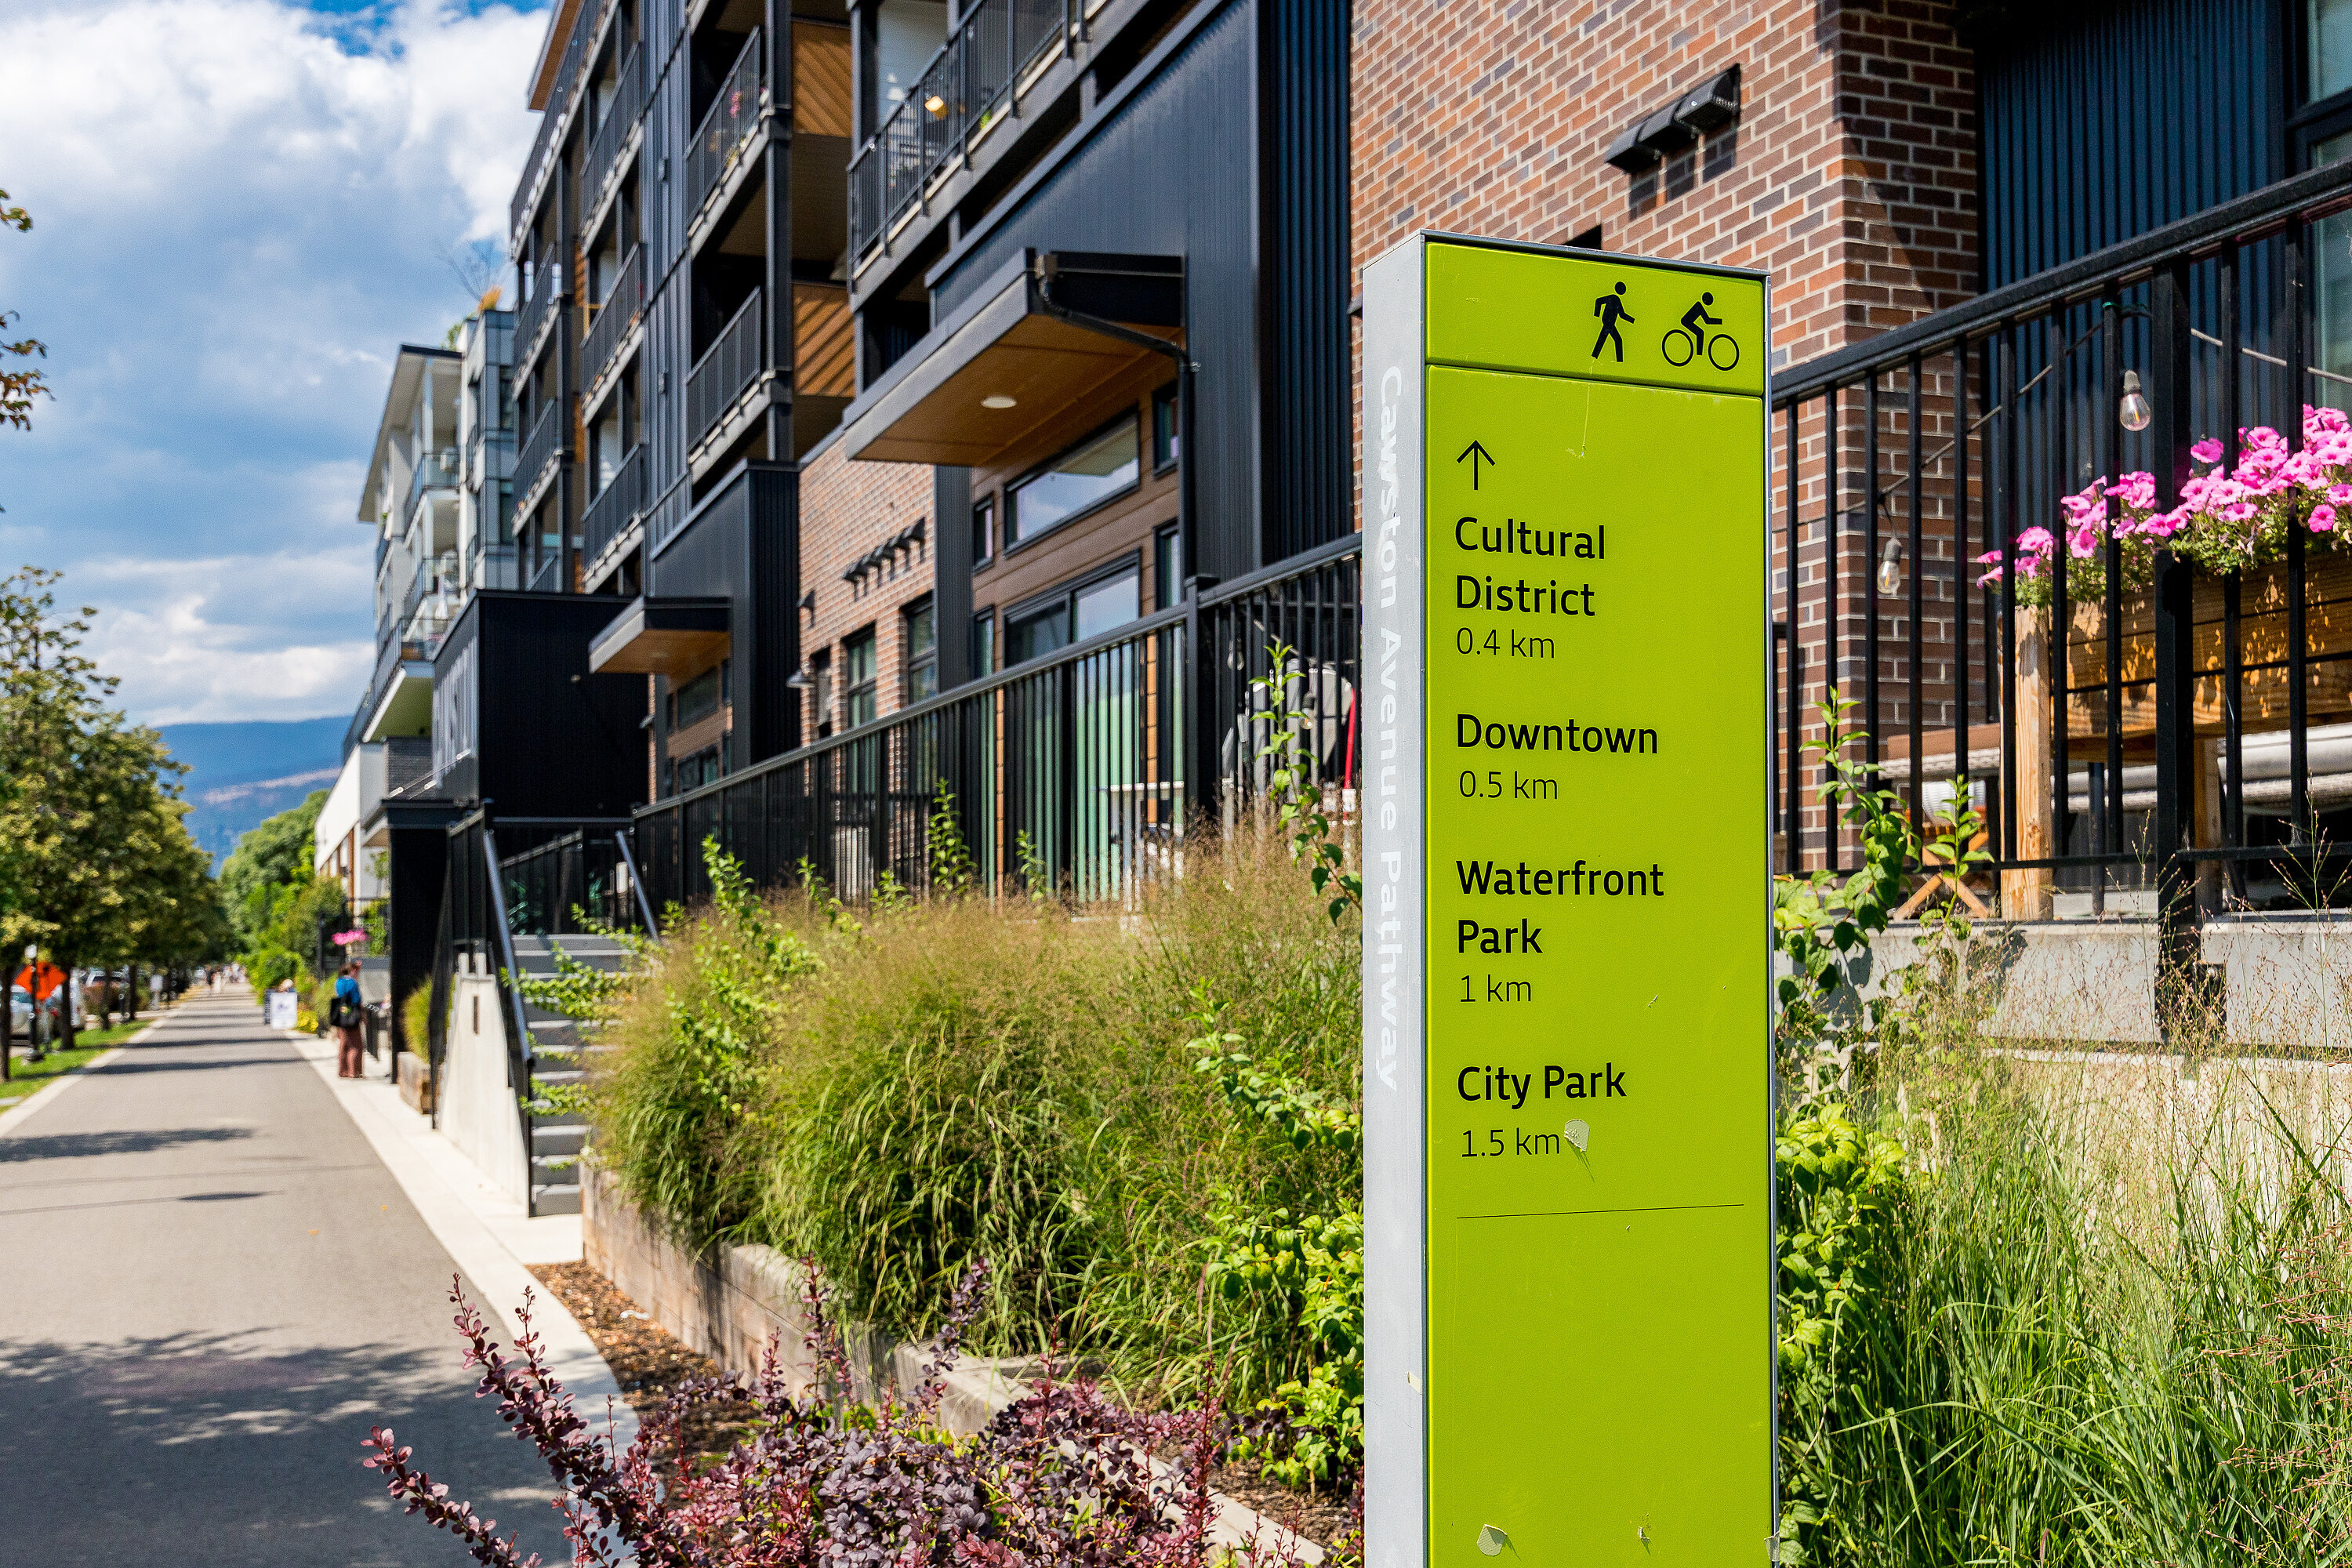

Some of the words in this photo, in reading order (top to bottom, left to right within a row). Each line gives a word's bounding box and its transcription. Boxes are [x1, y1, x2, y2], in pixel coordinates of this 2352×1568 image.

[1380, 365, 1401, 608] Cawston
[1455, 516, 1605, 560] Cultural
[1456, 575, 1595, 617] District
[1456, 627, 1501, 656] 0.4
[1510, 628, 1555, 659] km
[1381, 627, 1402, 831] Avenue
[1457, 713, 1657, 754] Downtown
[1458, 770, 1503, 799] 0.5
[1513, 770, 1559, 800] km
[1455, 859, 1664, 897] Waterfront
[1457, 917, 1543, 954] Park
[1378, 851, 1402, 1091] Pathway
[1459, 975, 1476, 1003] 1
[1486, 974, 1532, 1002] km
[1457, 1065, 1532, 1110] City
[1543, 1062, 1628, 1099] Park
[1461, 1129, 1505, 1158] 1.5
[1515, 1127, 1561, 1156] km
